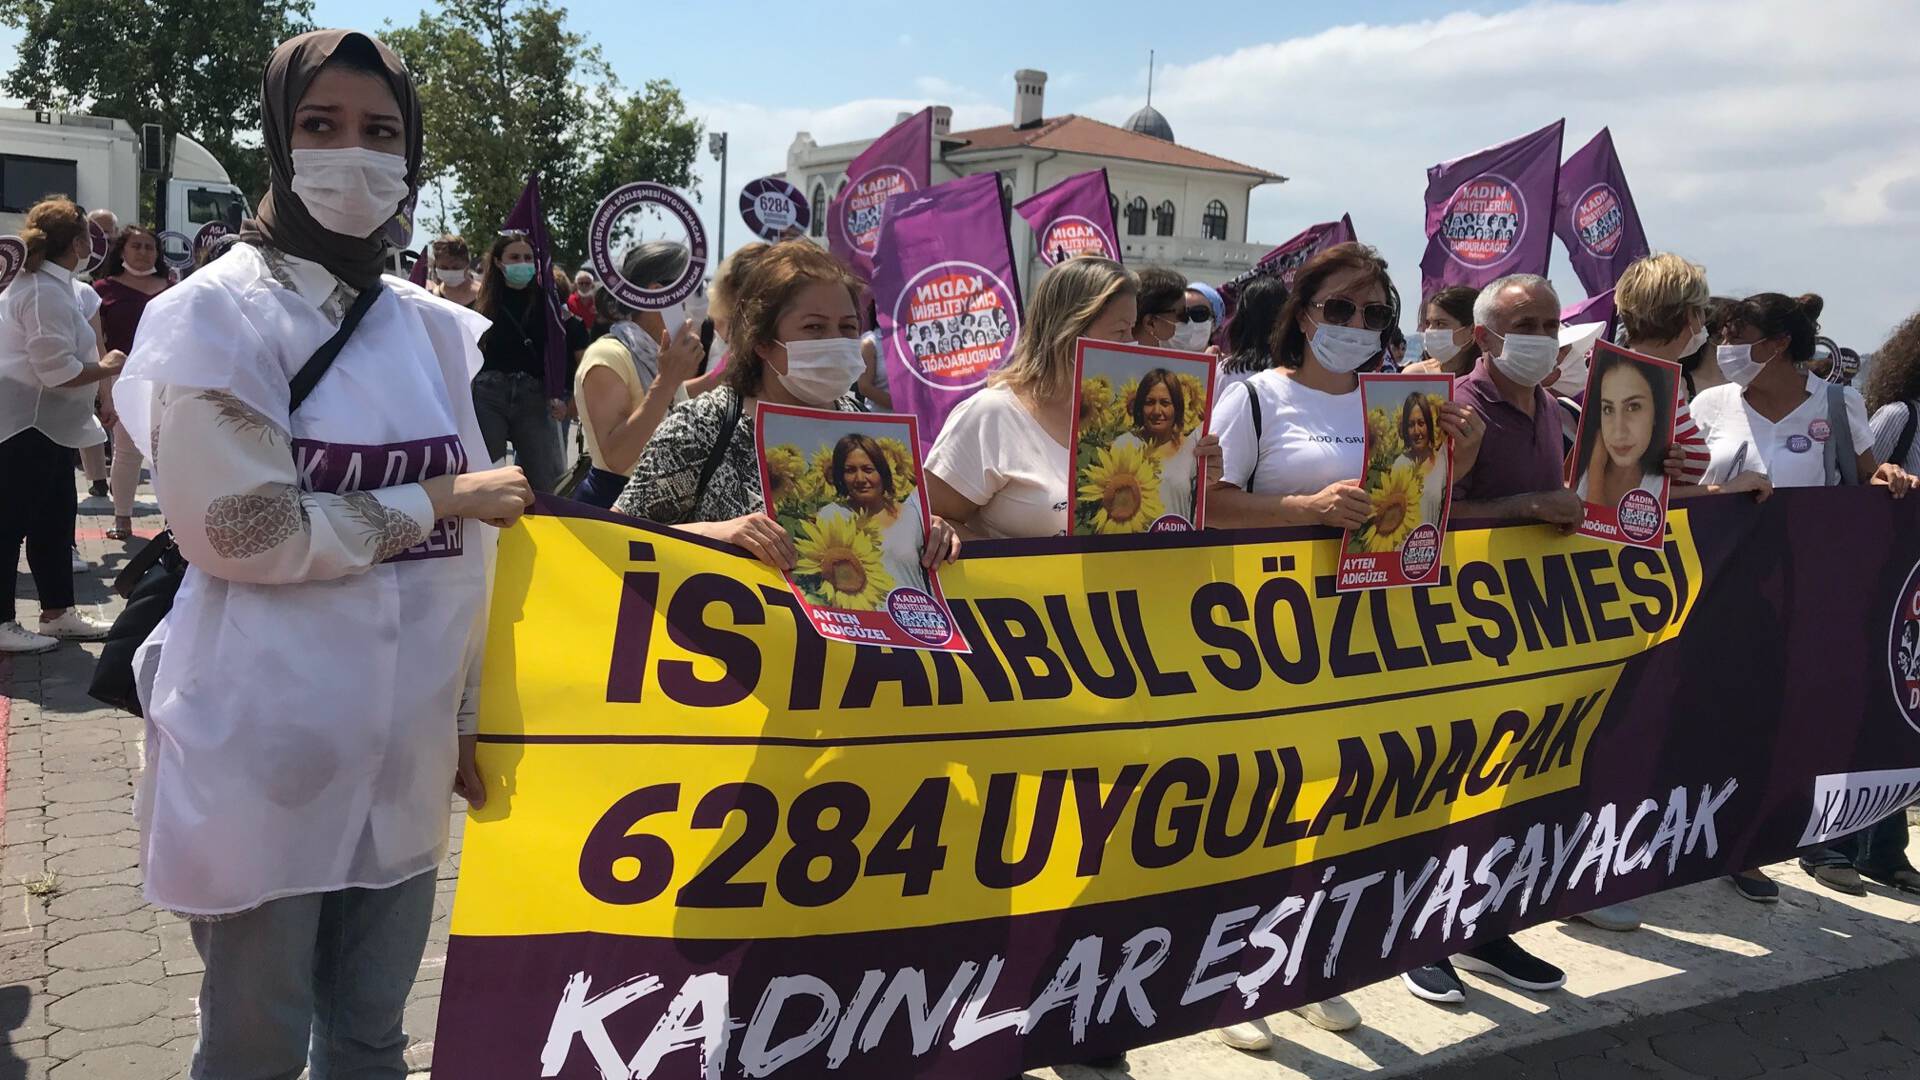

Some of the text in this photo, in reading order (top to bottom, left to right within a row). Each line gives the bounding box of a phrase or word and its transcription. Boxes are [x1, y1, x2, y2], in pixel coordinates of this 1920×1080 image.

[858, 173, 900, 195] KADIN
[1463, 185, 1507, 199] KADIN
[760, 196, 790, 214] 6284
[298, 440, 465, 493] KADIN
[1629, 494, 1654, 504] KADIN
[1158, 522, 1187, 532] KADIN
[1343, 557, 1376, 571] AYTEN
[1341, 570, 1388, 585] ADIGÜZEL
[893, 594, 928, 604] KADIN
[606, 522, 1689, 711] İSTANBUL SÖZLEŞMESİ
[812, 609, 860, 626] AYTEN
[820, 622, 892, 641] ADIGÜZEL
[578, 690, 1606, 909] 6284 UYGULANACAK
[540, 776, 1739, 1080] KADINLAR EŞİT YAŞAYACAK
